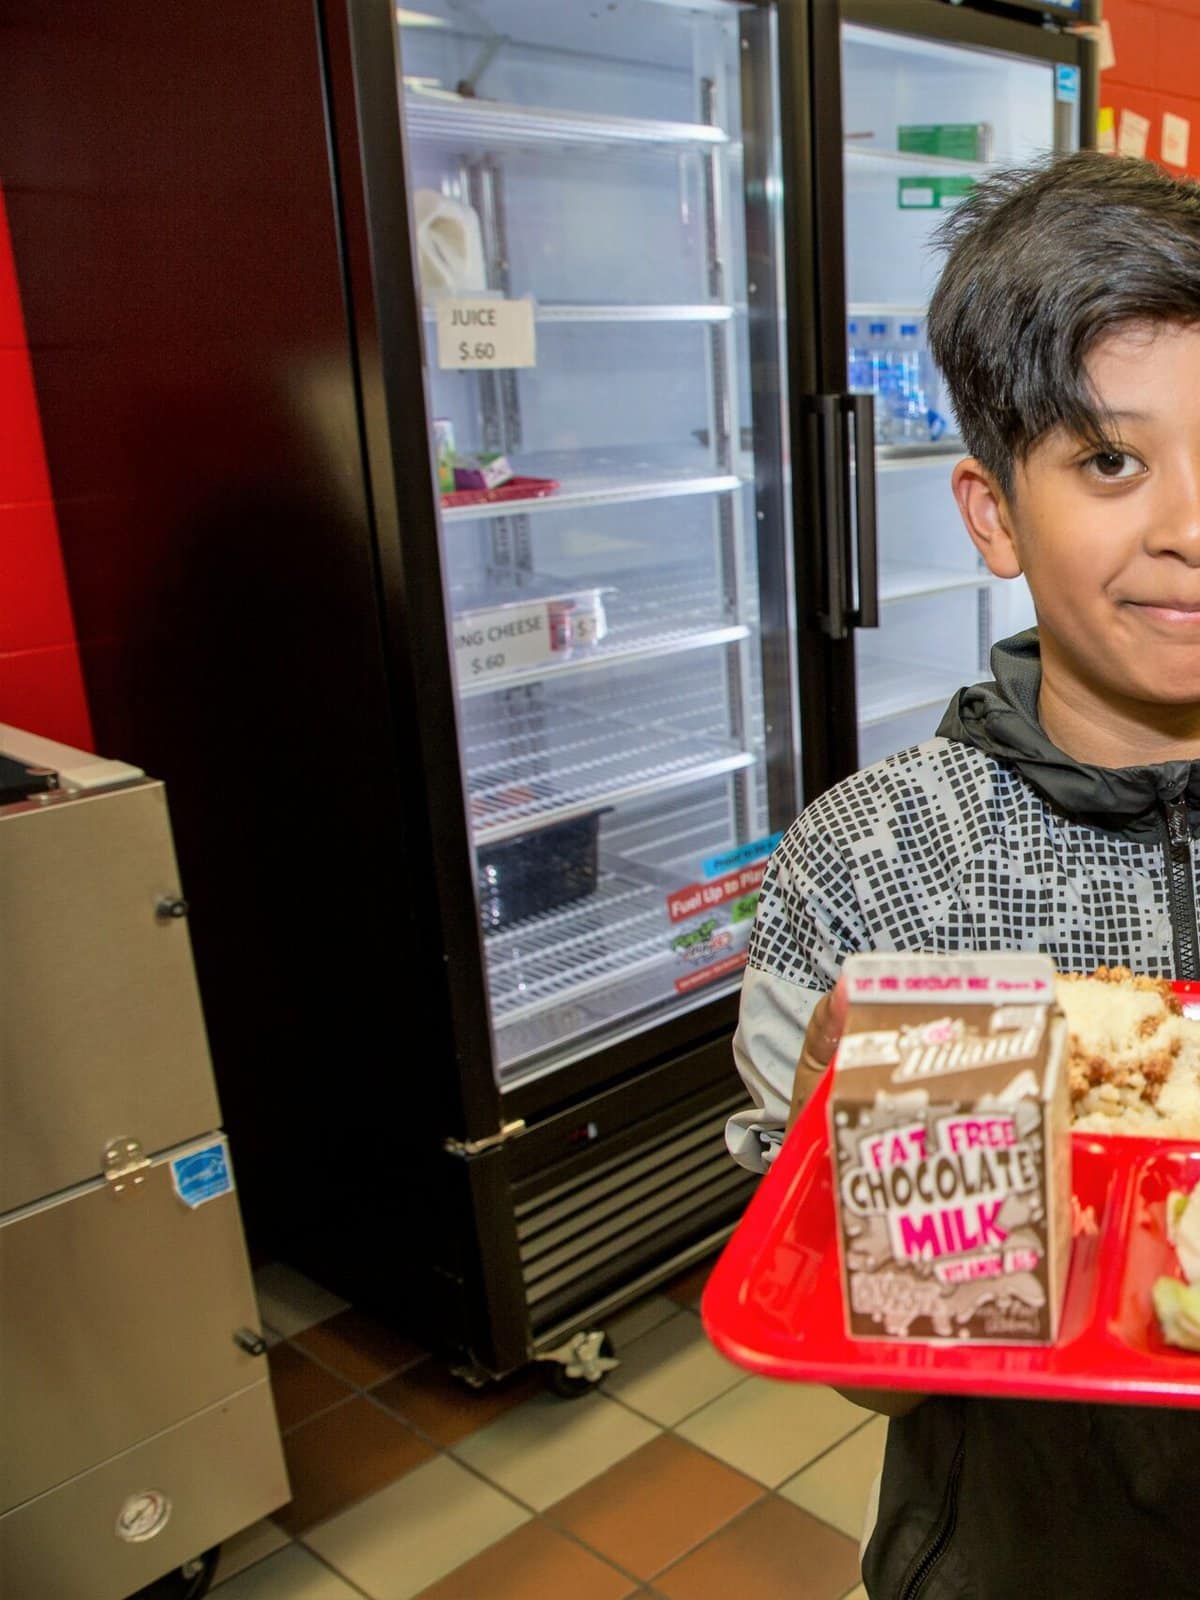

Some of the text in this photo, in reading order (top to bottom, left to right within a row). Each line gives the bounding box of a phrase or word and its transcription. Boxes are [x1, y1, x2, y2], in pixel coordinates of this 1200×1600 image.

[450, 308, 497, 327] JUICE
[459, 341, 496, 361] $.60
[487, 615, 542, 641] CHEESE
[470, 653, 505, 674] $.60
[671, 890, 703, 918] Fuel
[702, 885, 723, 904] Up
[724, 881, 739, 895] to
[871, 1119, 1017, 1169] FAT FREE
[850, 1150, 1034, 1209] CHOCOLATE
[899, 1200, 1009, 1257] MILK
